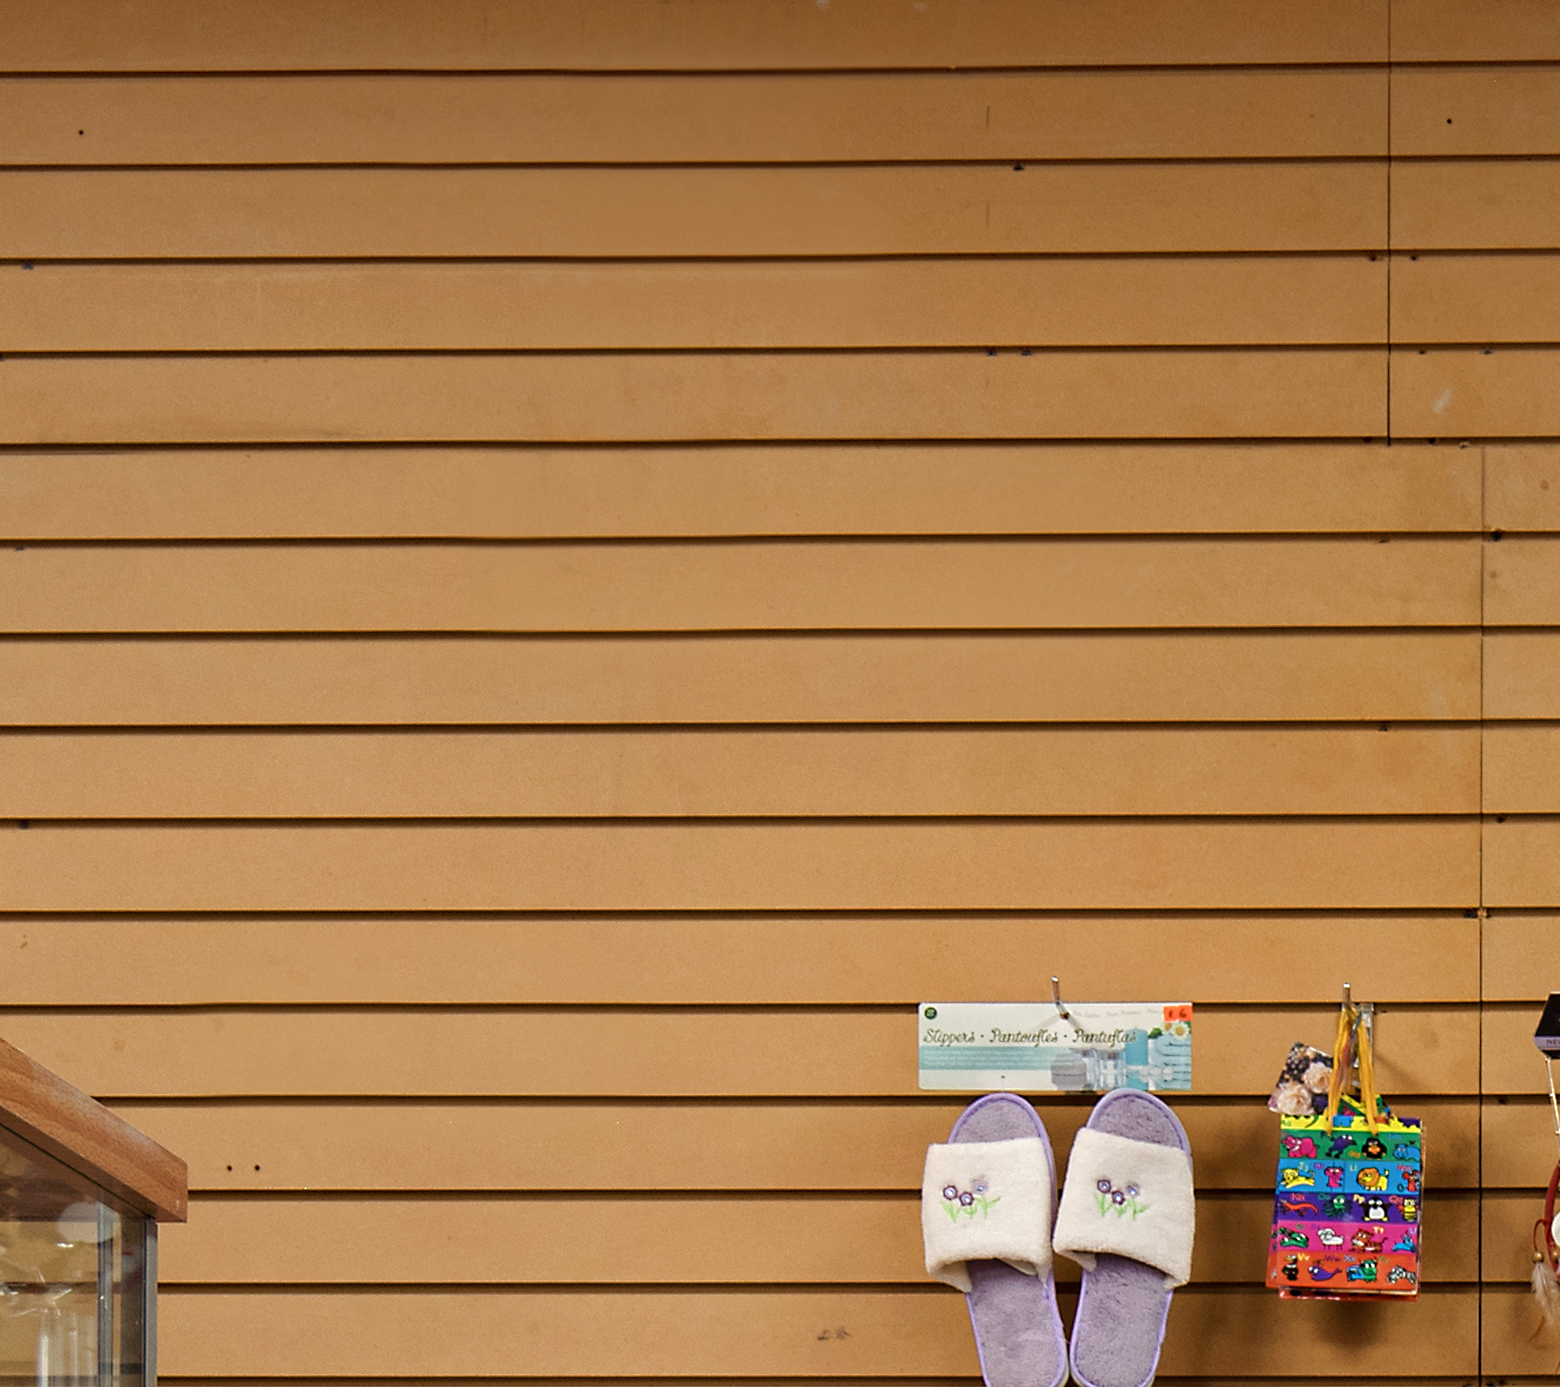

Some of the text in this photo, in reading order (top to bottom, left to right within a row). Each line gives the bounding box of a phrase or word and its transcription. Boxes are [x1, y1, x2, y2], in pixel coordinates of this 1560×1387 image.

[924, 1028, 1137, 1048] Slippers Pantoufles Pantuflas
